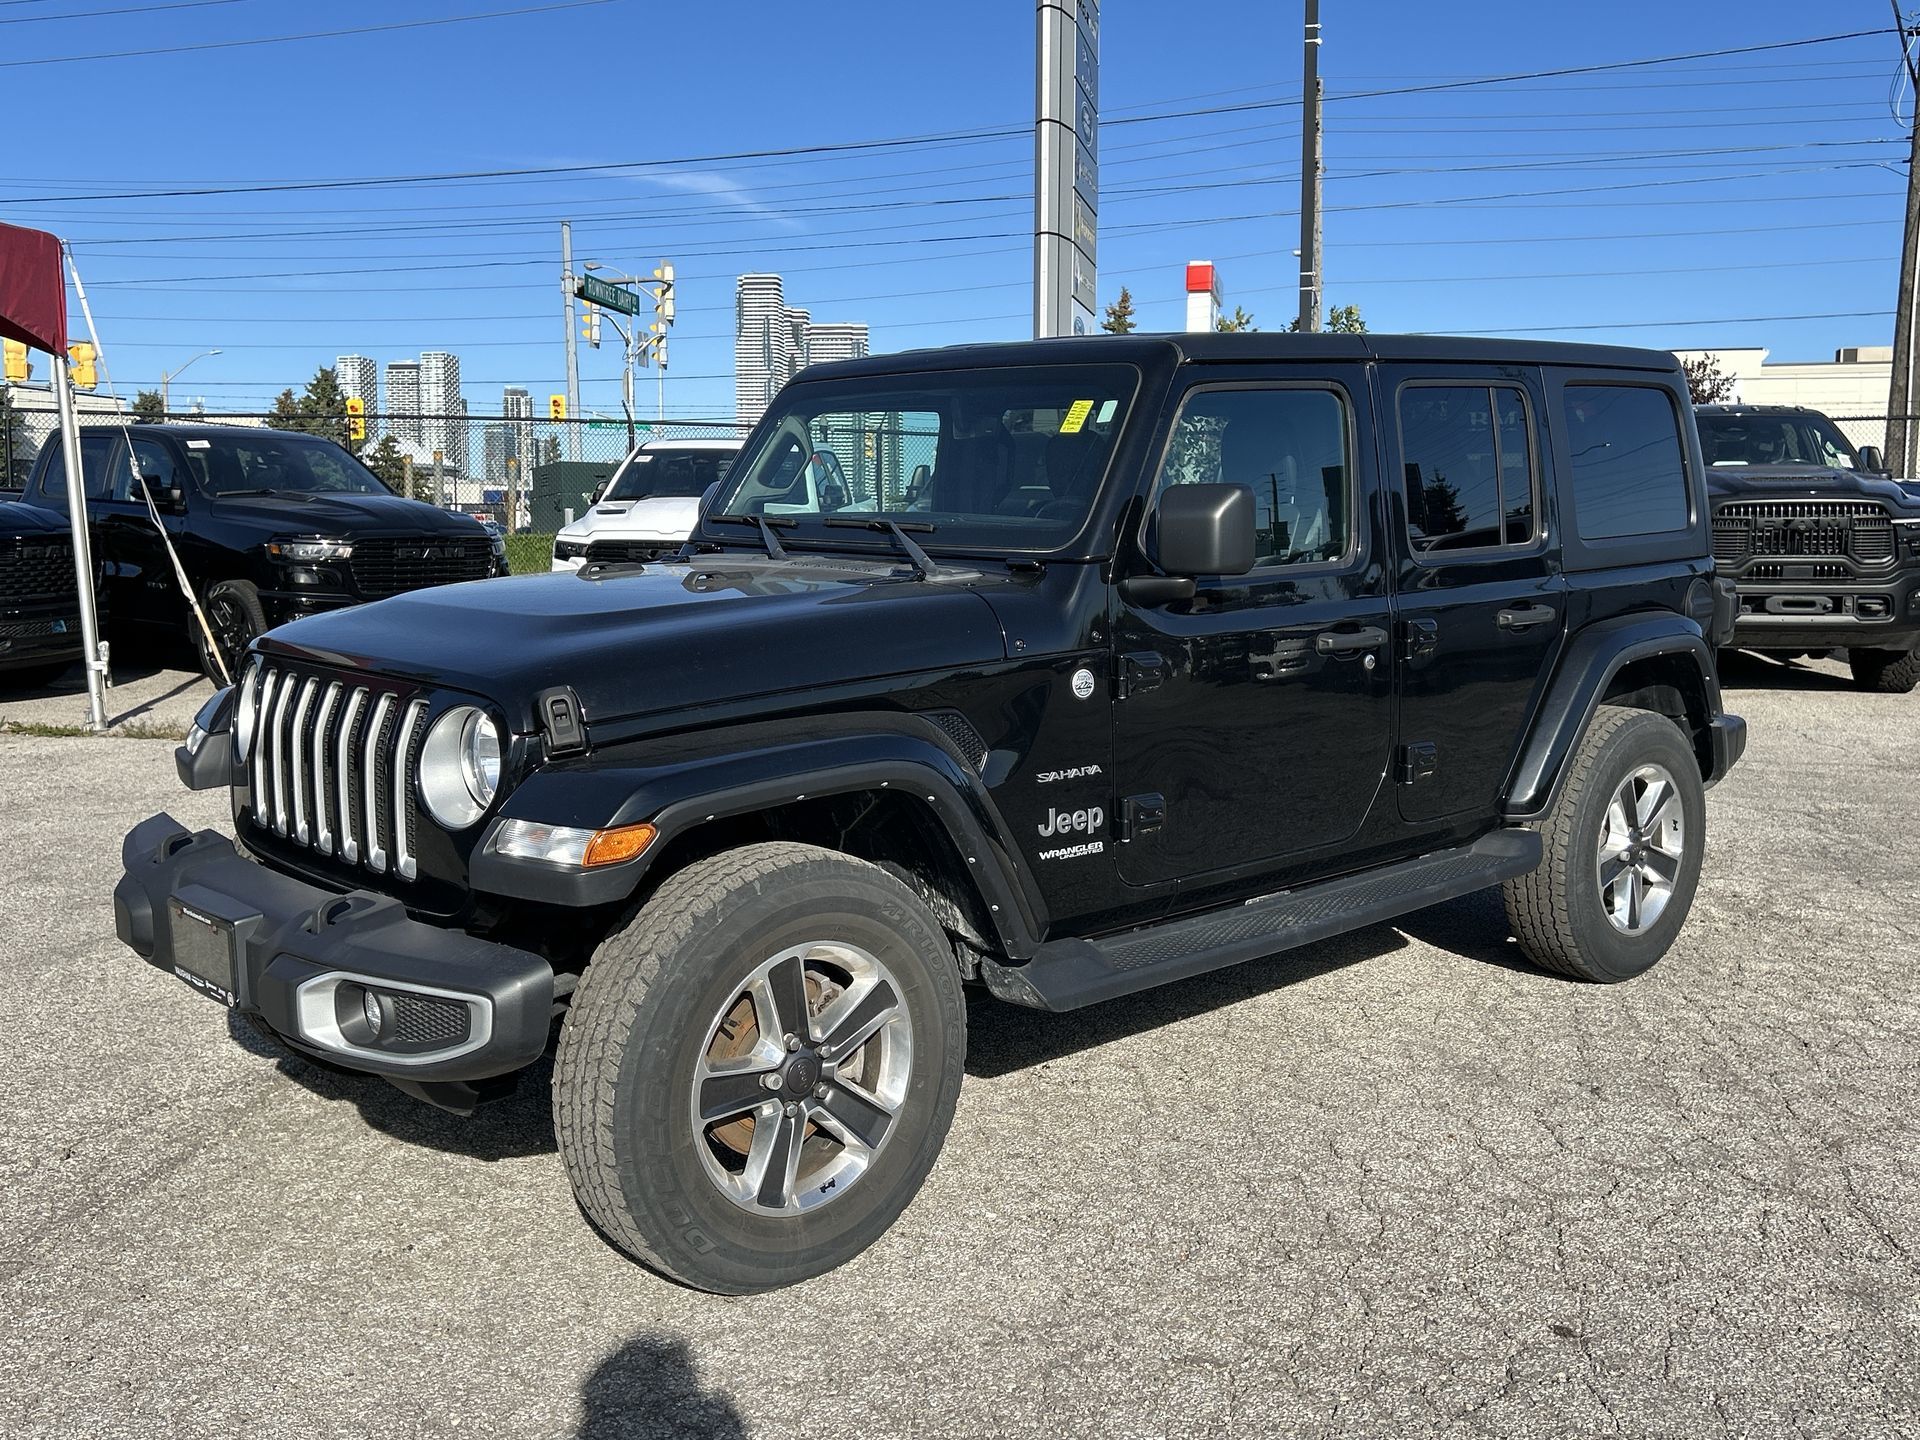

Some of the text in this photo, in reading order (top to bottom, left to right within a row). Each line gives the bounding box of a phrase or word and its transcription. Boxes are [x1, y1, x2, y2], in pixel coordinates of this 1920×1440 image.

[1036, 764, 1103, 783] SAHARA
[1037, 806, 1104, 837] Jeep
[1038, 841, 1104, 861] WRANGLER
